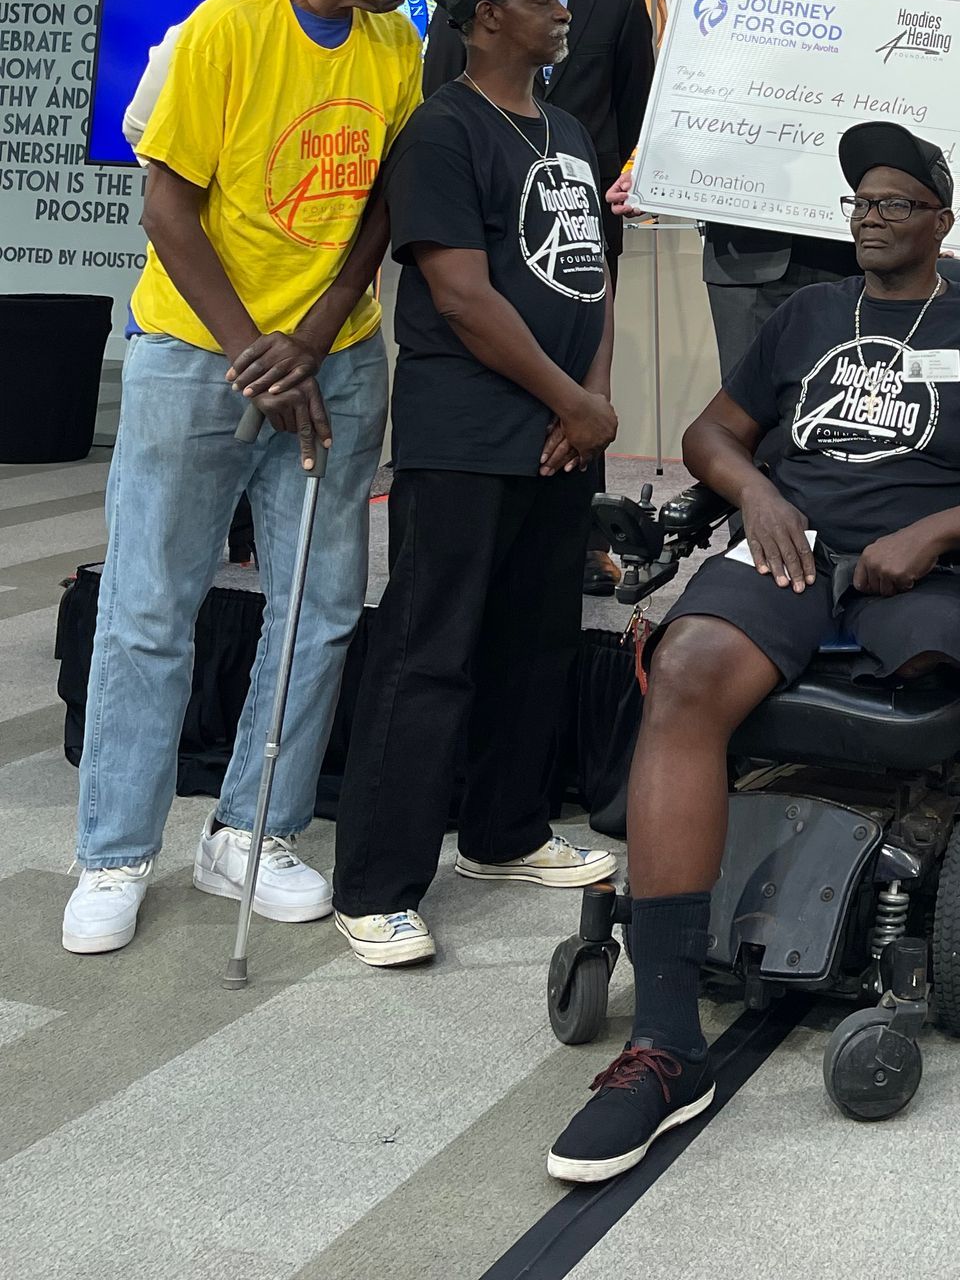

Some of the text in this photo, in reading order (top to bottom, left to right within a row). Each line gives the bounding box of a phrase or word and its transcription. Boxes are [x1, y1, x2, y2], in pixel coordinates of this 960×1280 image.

[73, 4, 99, 25] O
[733, 14, 843, 41] FOR GOOD
[897, 8, 942, 30] Hoodies
[0, 29, 72, 53] EBRATE
[730, 32, 839, 54] FOUNDATION by Avolta
[907, 26, 952, 53] Healing
[45, 86, 89, 109] AND
[747, 80, 928, 123] Hoodies 4 Healing
[3, 112, 72, 136] SMART
[671, 109, 825, 147] Twenty-Five
[301, 125, 369, 160] Hoodies
[0, 168, 59, 193] STON
[67, 172, 84, 193] IS
[94, 173, 132, 196] THE
[321, 153, 378, 191] Healin
[690, 169, 765, 194] Donation
[537, 181, 590, 212] Hoodies
[35, 199, 129, 225] PROSPER
[557, 209, 602, 241] Healin
[0, 246, 53, 264] OPTED
[59, 249, 77, 265] BY
